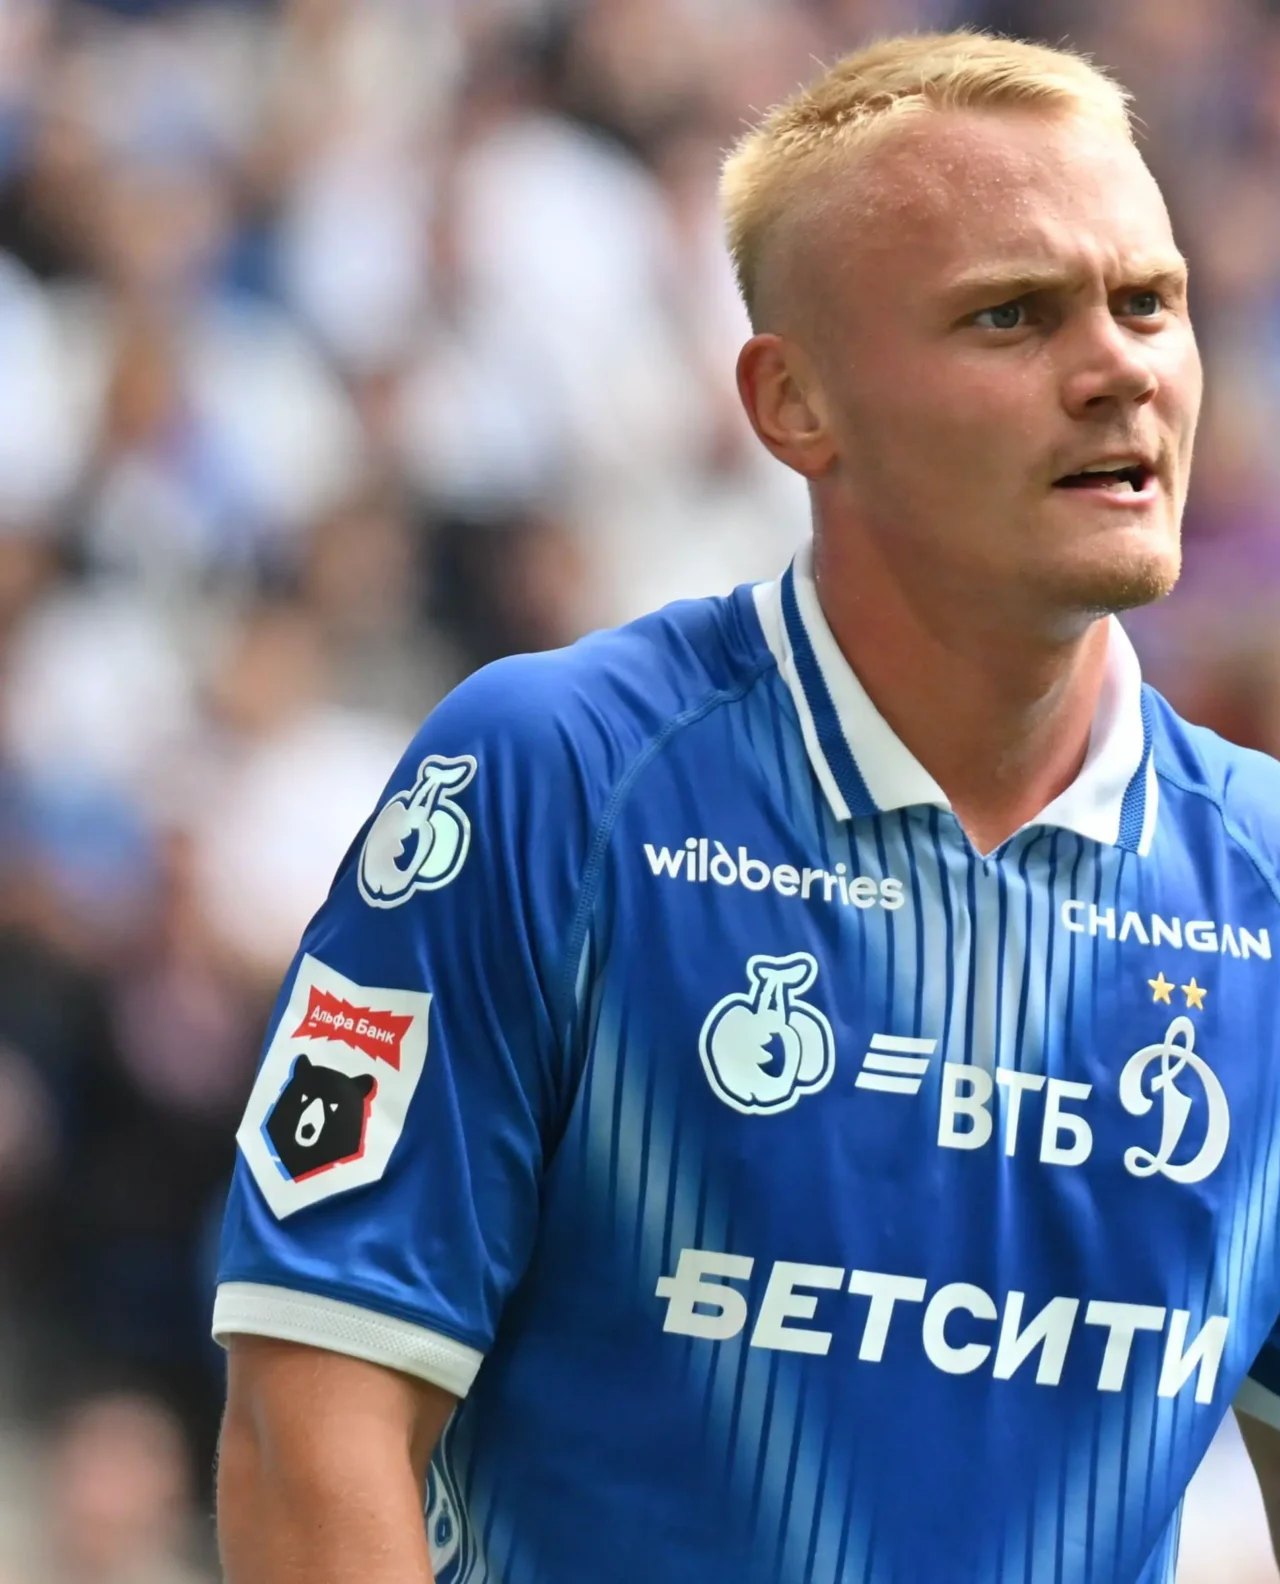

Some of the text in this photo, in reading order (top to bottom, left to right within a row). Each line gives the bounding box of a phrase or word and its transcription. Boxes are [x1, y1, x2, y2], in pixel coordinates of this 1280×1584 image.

[644, 837, 904, 910] wildberries
[1061, 900, 1272, 960] CHANGAN
[309, 1005, 395, 1044] Альфа Банк
[937, 1062, 1093, 1167] ВТБ
[655, 1248, 1229, 1405] БЕТСИТИ
